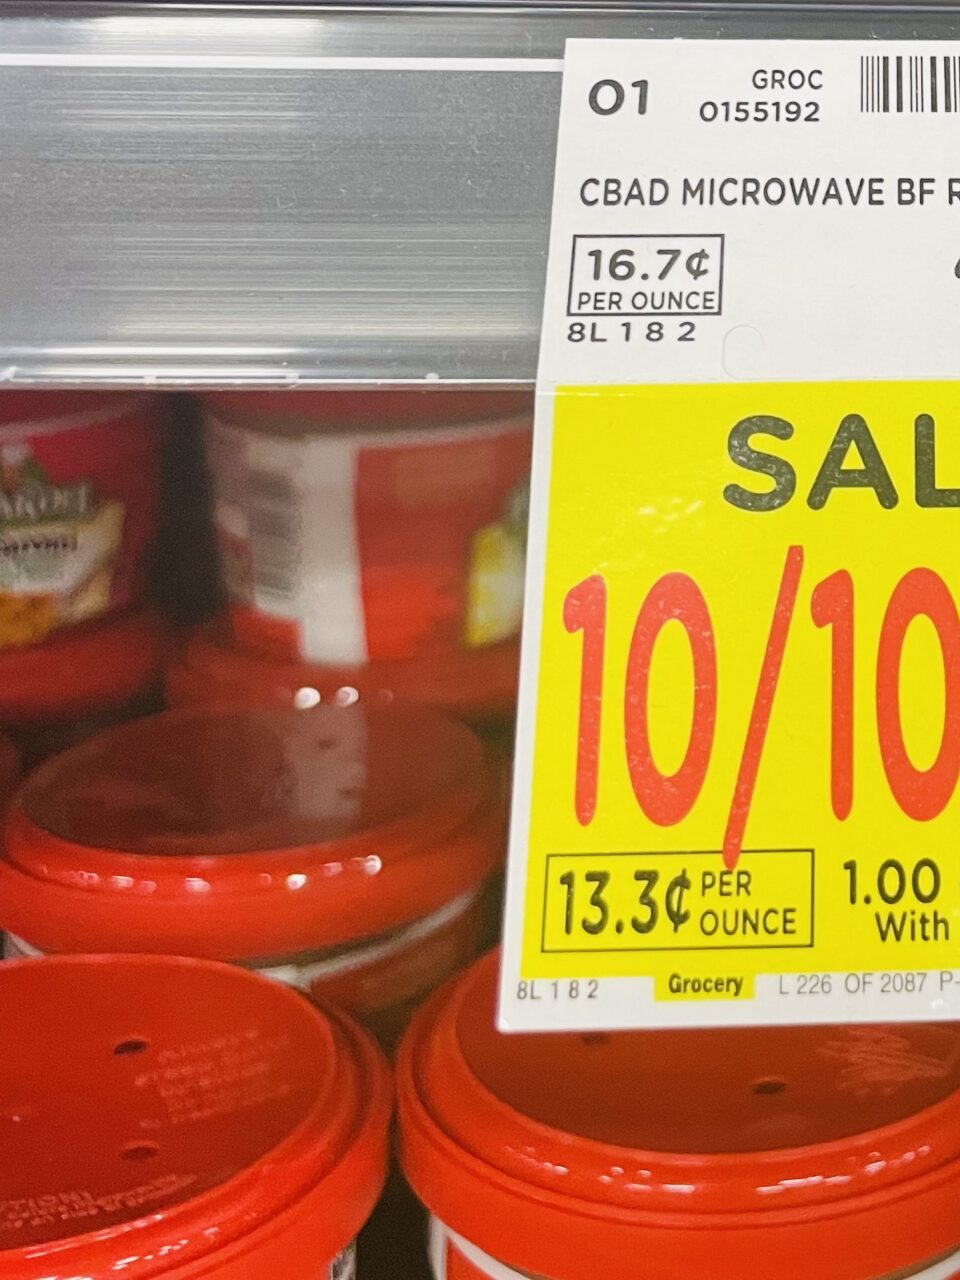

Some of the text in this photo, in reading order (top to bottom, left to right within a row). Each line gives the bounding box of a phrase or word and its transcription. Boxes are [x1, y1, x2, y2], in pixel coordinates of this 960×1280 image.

[588, 69, 823, 115] 01 GROC
[699, 101, 820, 122] 0155192
[580, 177, 670, 207] CBAD
[682, 177, 885, 207] MICROWAVE
[898, 177, 935, 205] BF
[588, 248, 710, 281] 16.7¢
[578, 291, 715, 311] PER OUNCE
[843, 857, 941, 905] 1.00
[560, 868, 752, 936] 13.3¢ PER
[700, 908, 797, 936] OUNCE
[875, 910, 950, 942] With
[668, 973, 744, 997] Grocery
[796, 974, 832, 995] 226
[844, 972, 873, 994] OF
[880, 972, 927, 993] 2087
